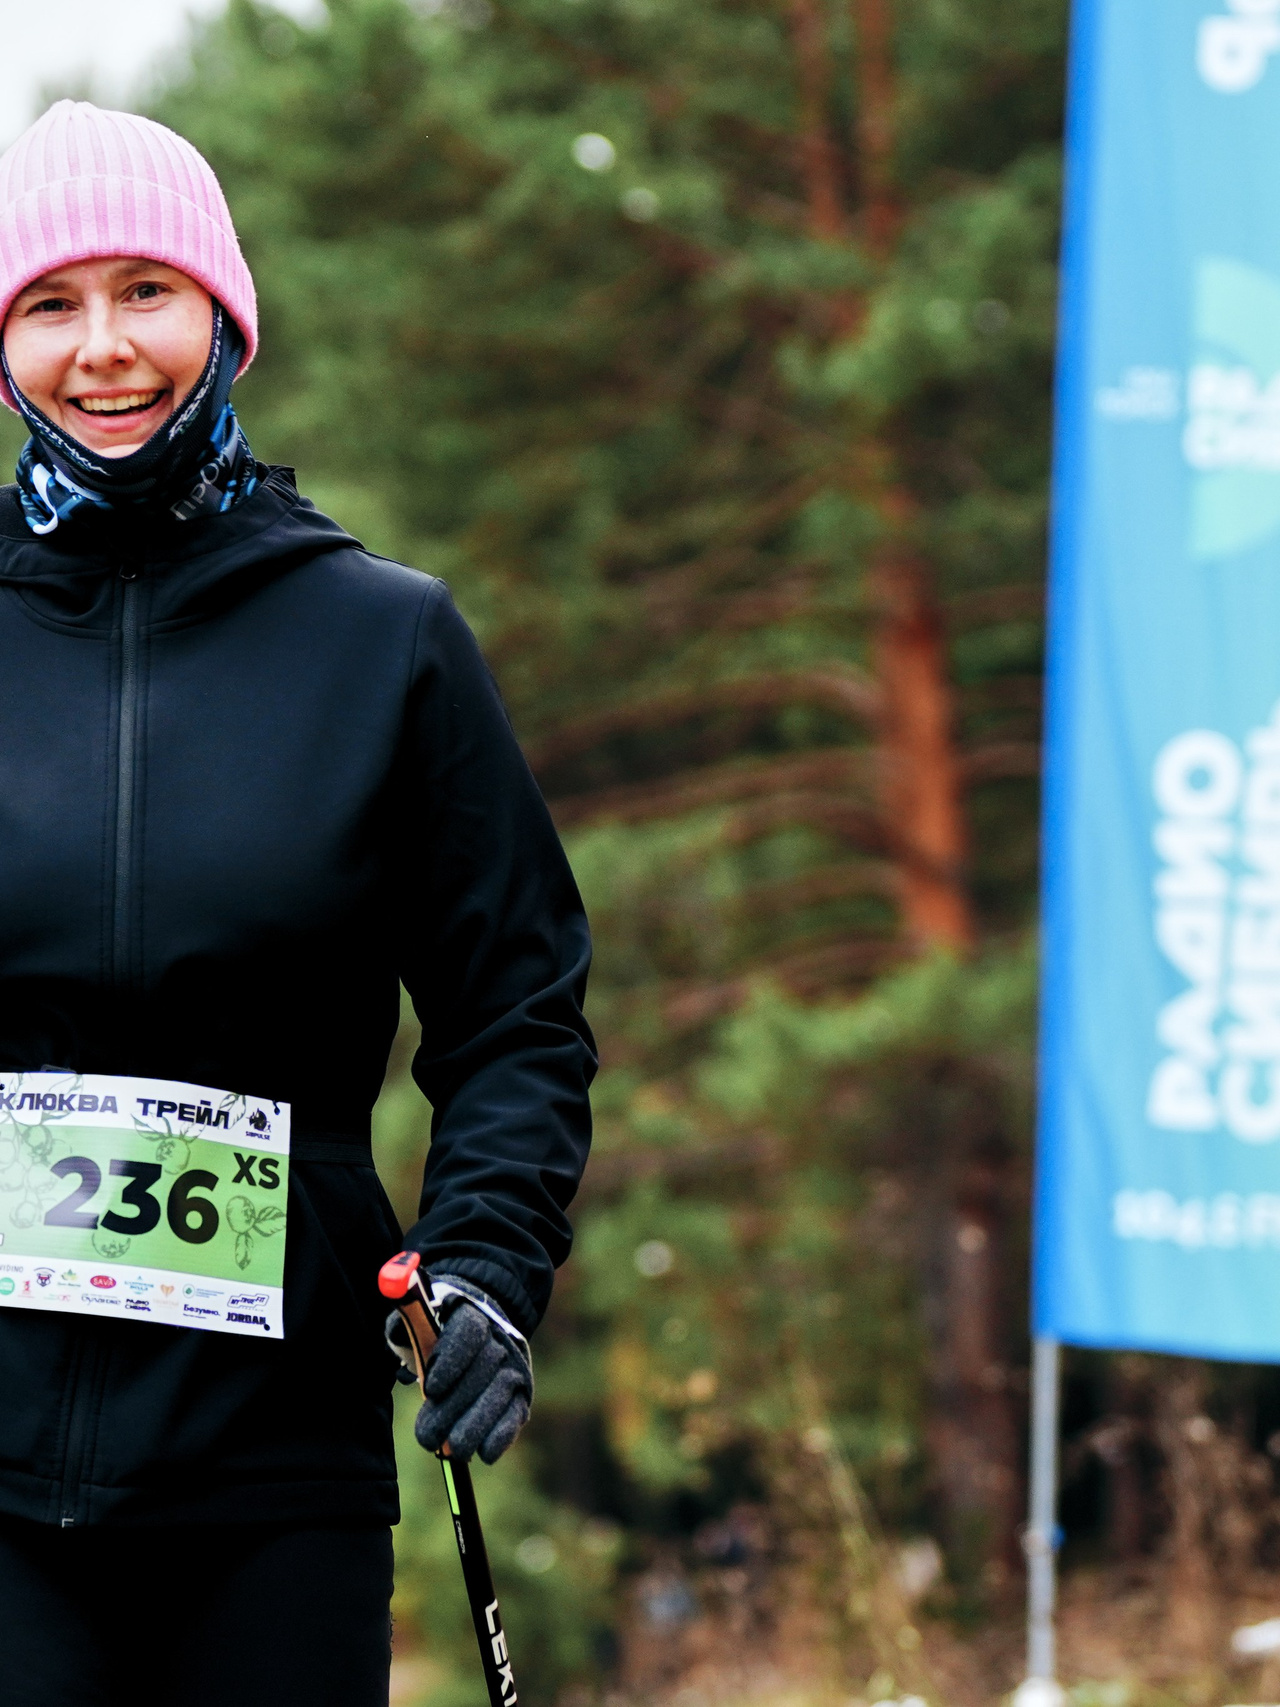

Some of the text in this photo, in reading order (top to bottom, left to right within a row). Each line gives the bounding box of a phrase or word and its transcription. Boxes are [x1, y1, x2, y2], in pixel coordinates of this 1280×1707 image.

[1146, 728, 1241, 1132] РАДИО
[136, 1098, 230, 1130] ТРЕЙЛ
[231, 1151, 281, 1190] XS
[43, 1155, 220, 1245] 236
[93, 1277, 114, 1287] SAVA
[225, 1312, 267, 1325] JORDAN
[485, 1598, 518, 1707] LEKI
